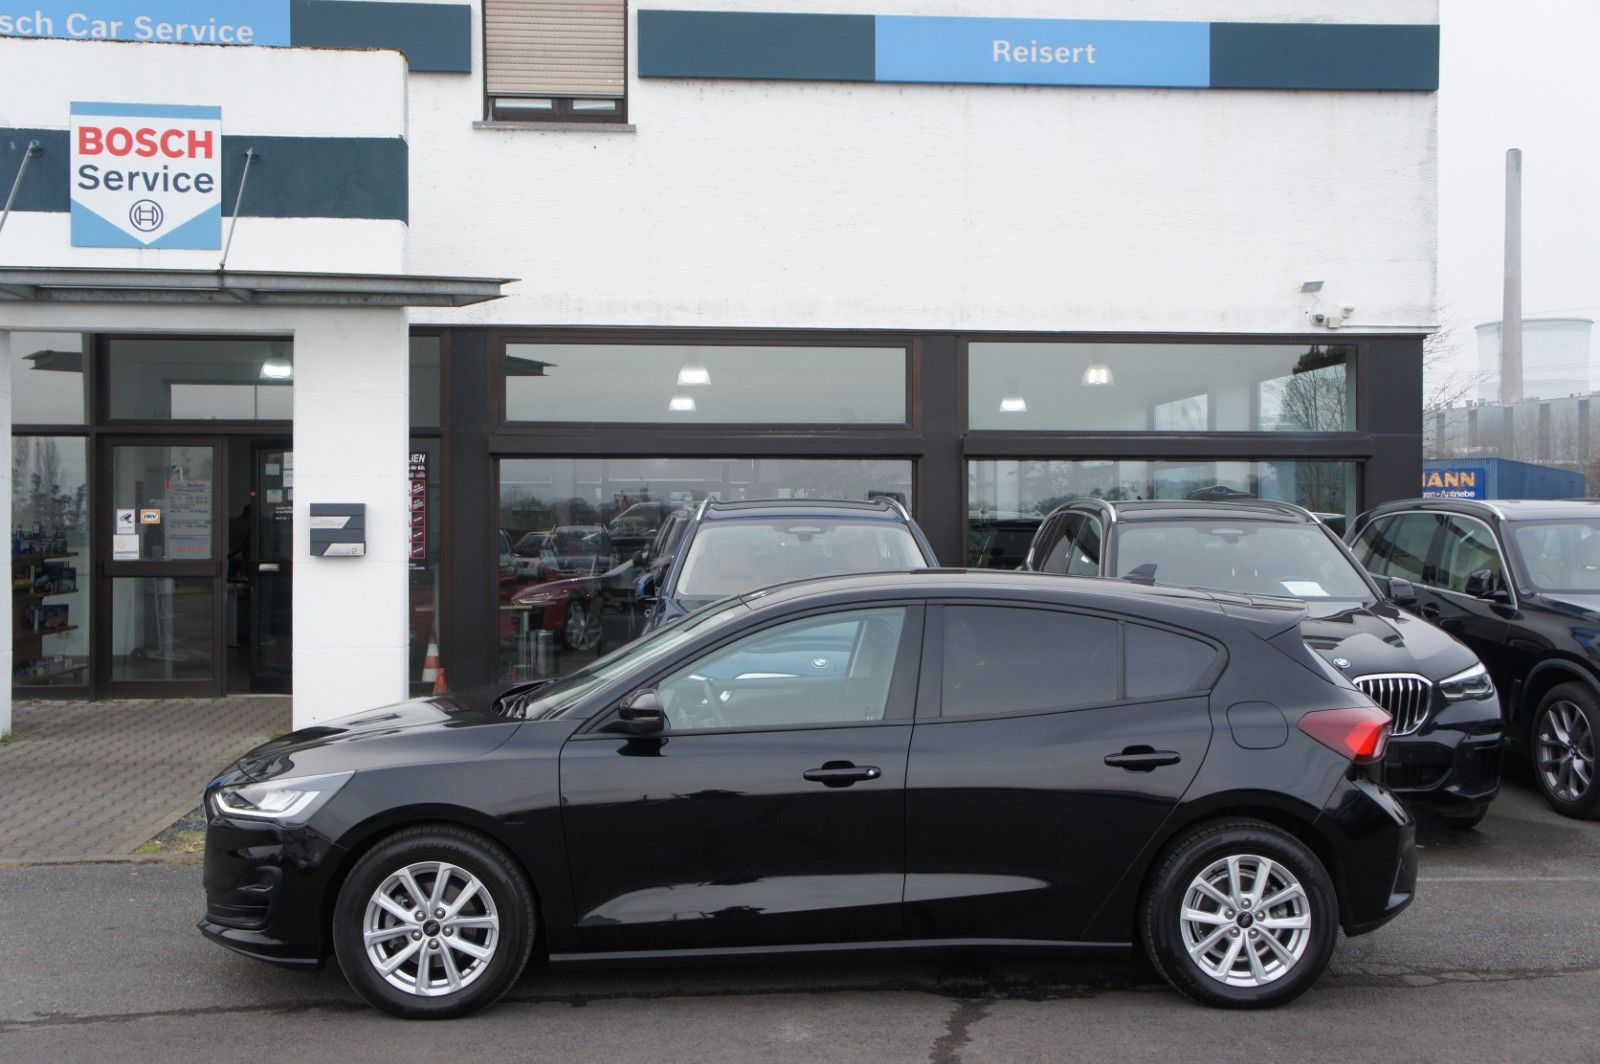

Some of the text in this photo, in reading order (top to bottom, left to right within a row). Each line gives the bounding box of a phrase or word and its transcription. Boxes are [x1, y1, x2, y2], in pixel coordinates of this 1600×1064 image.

[0, 10, 254, 43] sch Car Service
[992, 39, 1097, 64] Reisert
[78, 126, 213, 159] BOSCH
[77, 164, 214, 193] Service
